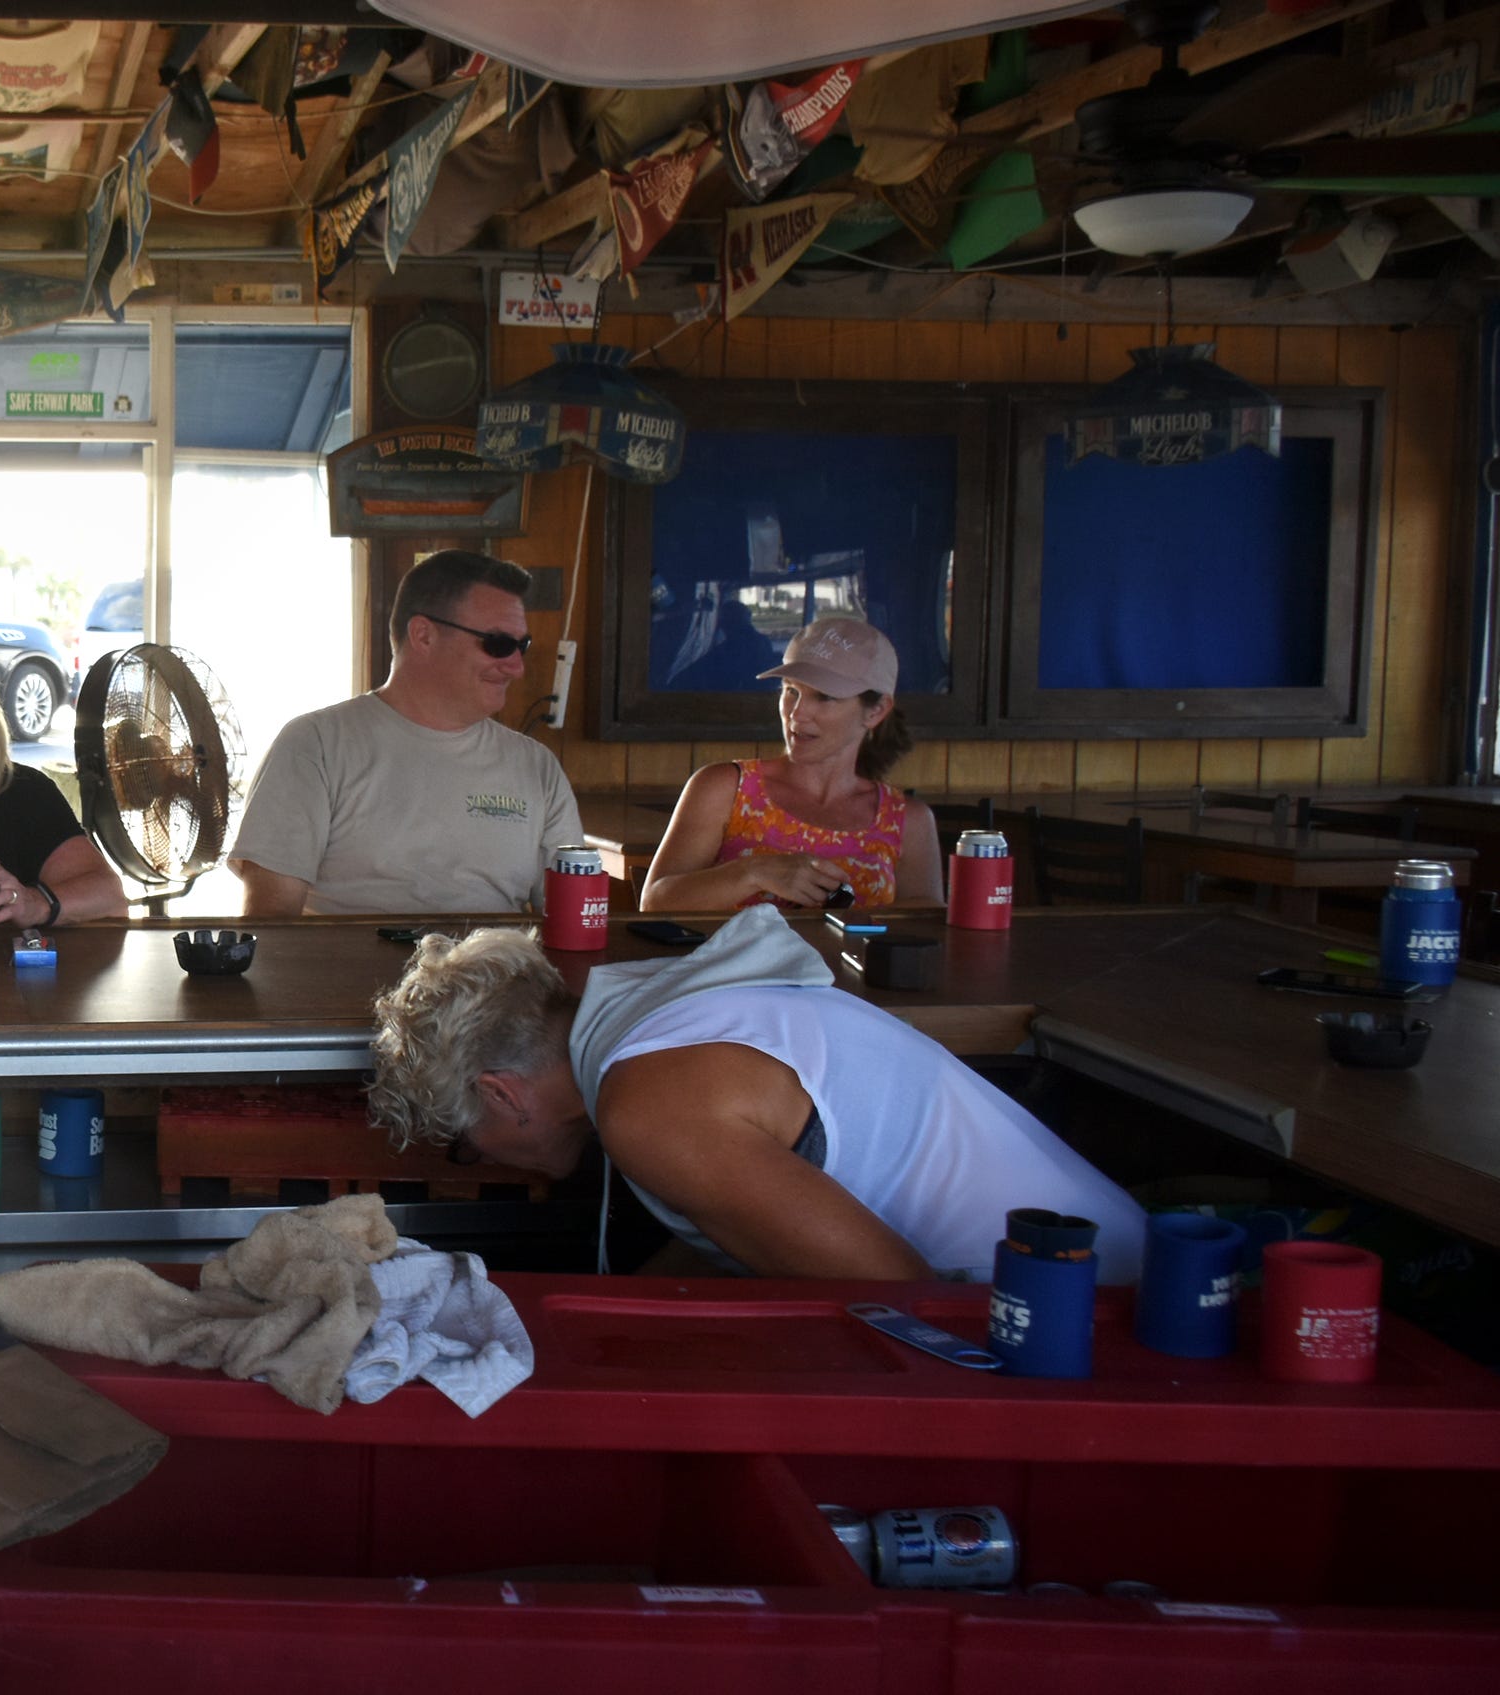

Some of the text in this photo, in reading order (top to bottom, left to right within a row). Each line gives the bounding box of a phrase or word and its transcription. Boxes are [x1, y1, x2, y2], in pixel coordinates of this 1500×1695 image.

[781, 66, 853, 135] CHAMPIONS
[762, 206, 819, 267] NEBRASKA
[505, 300, 594, 318] FLORIDA
[9, 391, 32, 412] SAVE
[33, 392, 69, 412] FENWAY
[69, 393, 94, 412] PARK
[1129, 411, 1213, 435] MICHELOB
[1406, 935, 1461, 951] JACK'
